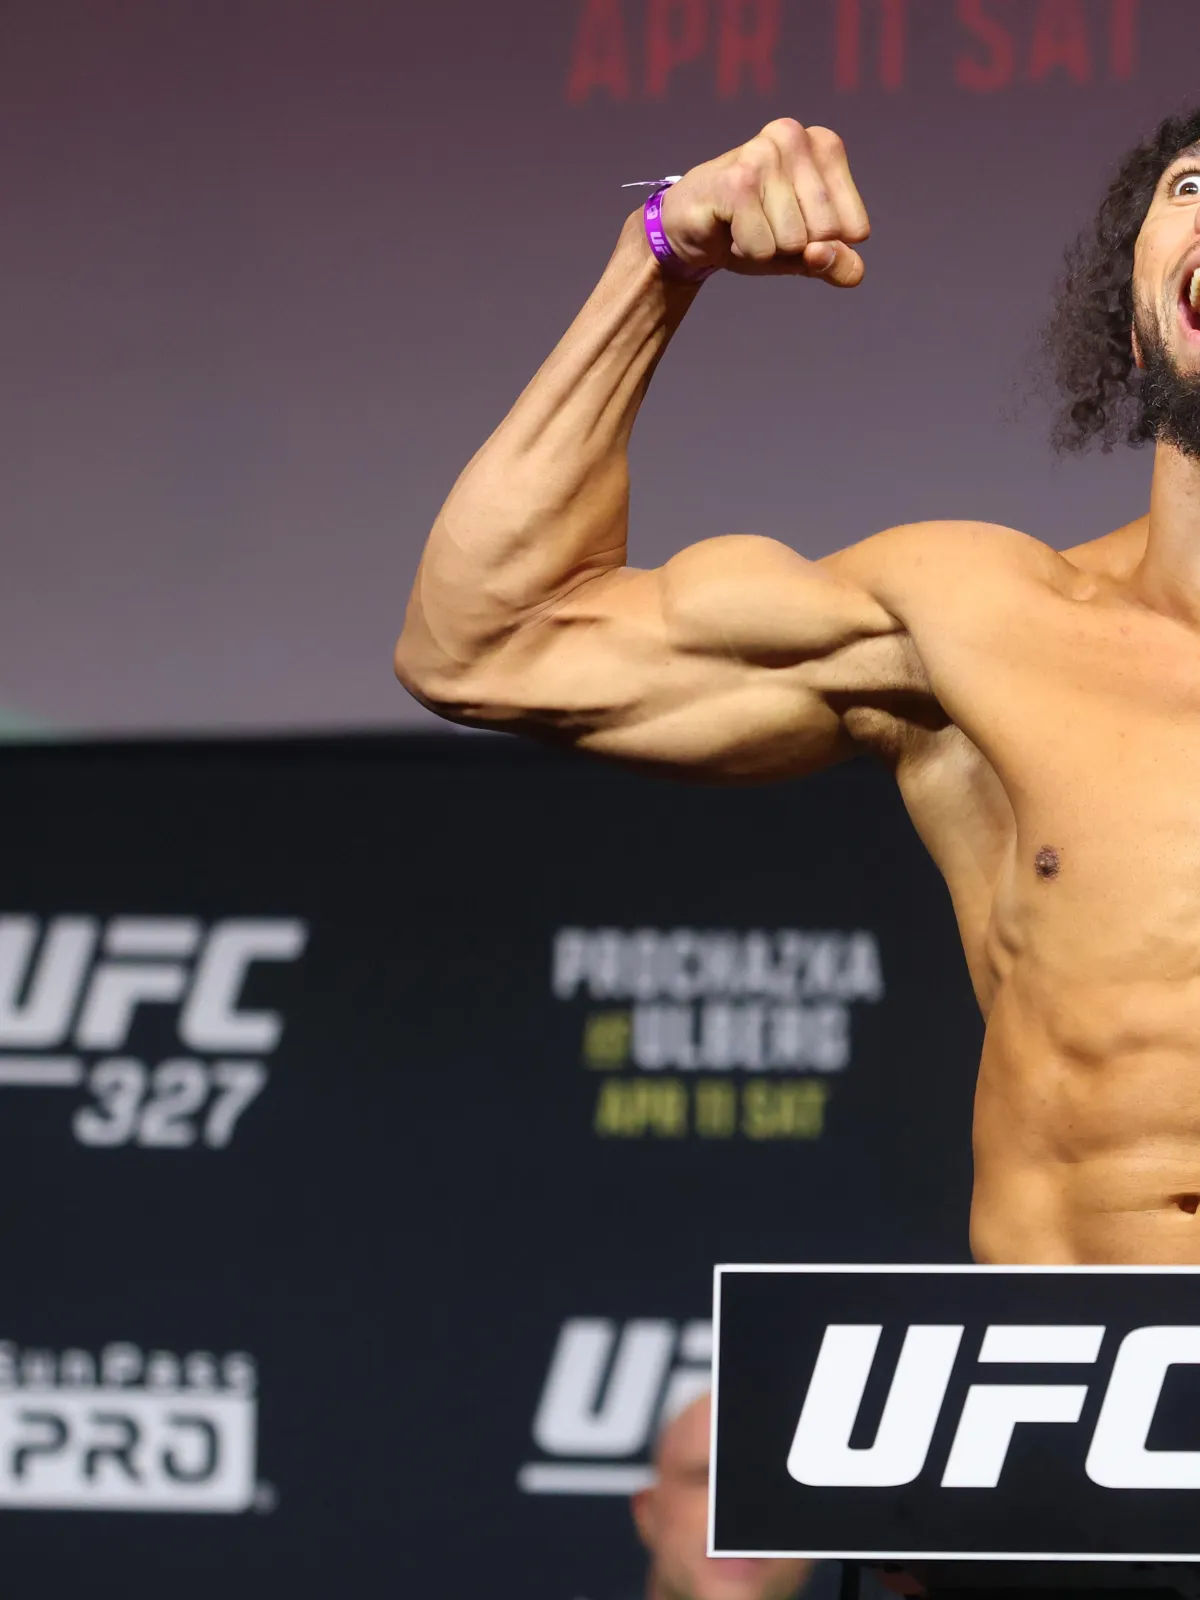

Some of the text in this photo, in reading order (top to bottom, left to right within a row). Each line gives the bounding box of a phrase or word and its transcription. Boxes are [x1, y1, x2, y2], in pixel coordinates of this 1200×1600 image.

[0, 912, 308, 1052] UFC
[632, 1003, 851, 1071] ULBERG
[72, 1056, 268, 1149] 327
[595, 1078, 687, 1139] APR
[742, 1078, 827, 1140] SAT
[12, 1409, 219, 1485] PRO
